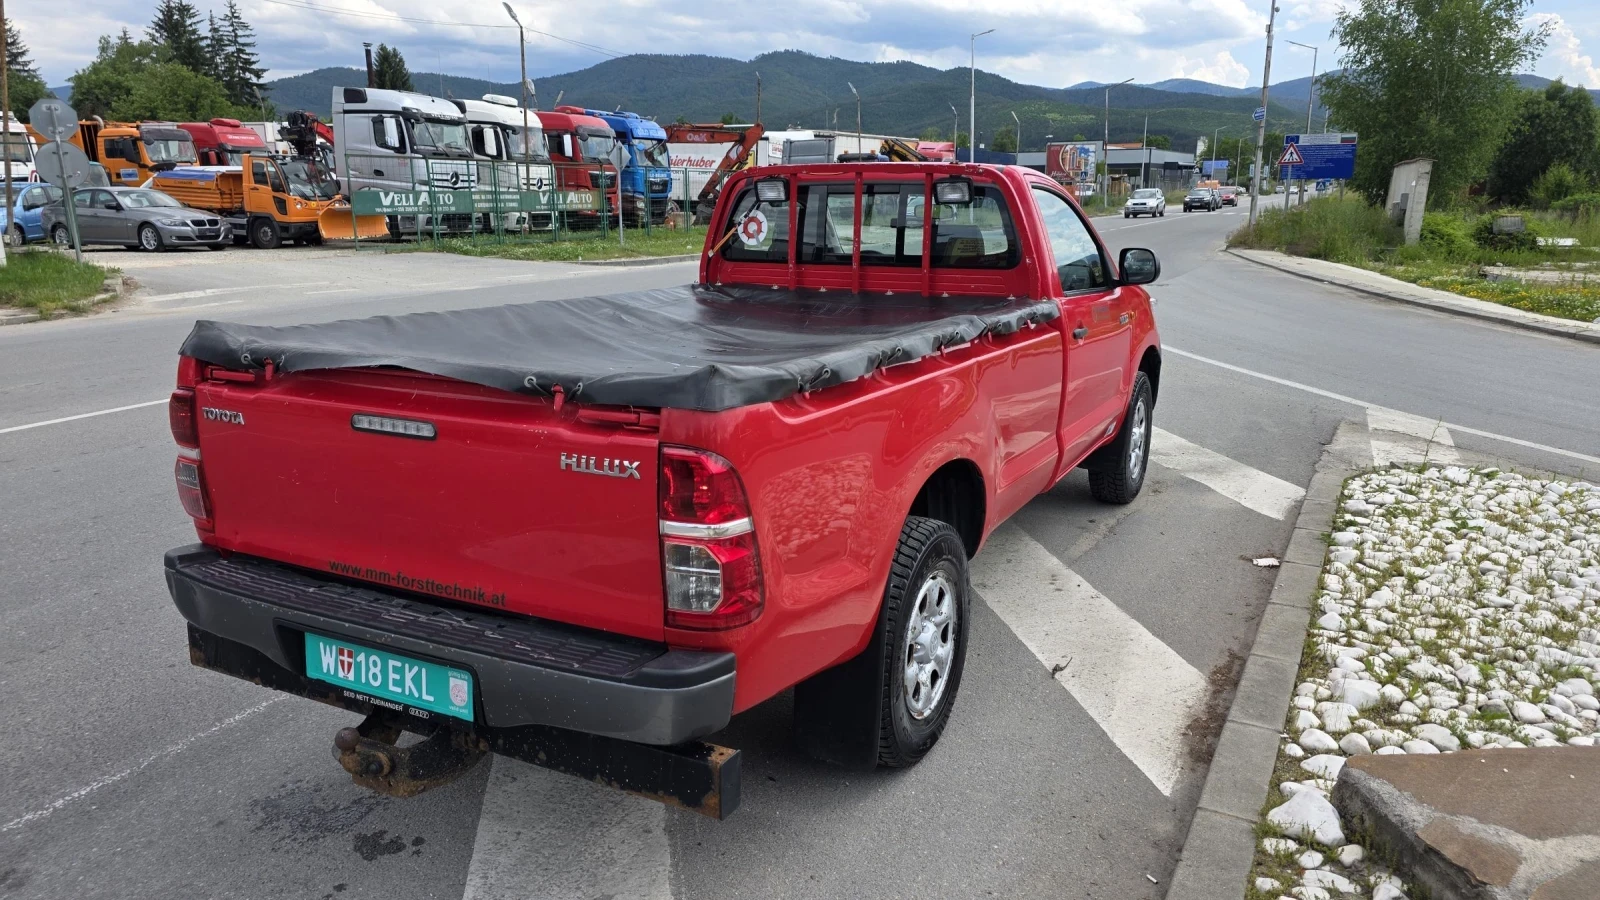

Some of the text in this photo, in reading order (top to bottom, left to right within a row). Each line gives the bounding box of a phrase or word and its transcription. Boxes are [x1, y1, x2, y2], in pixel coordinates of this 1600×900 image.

[687, 133, 707, 142] O&K
[379, 191, 454, 206] VELI ATO
[566, 191, 593, 204] AUTO
[202, 407, 245, 425] TOYOTA
[560, 452, 641, 480] HILUX
[329, 560, 507, 607] www.mm-forsttechnik.at
[319, 641, 435, 702] W 18 EKL
[343, 690, 403, 712] SEID NETT ZUEINANDER
